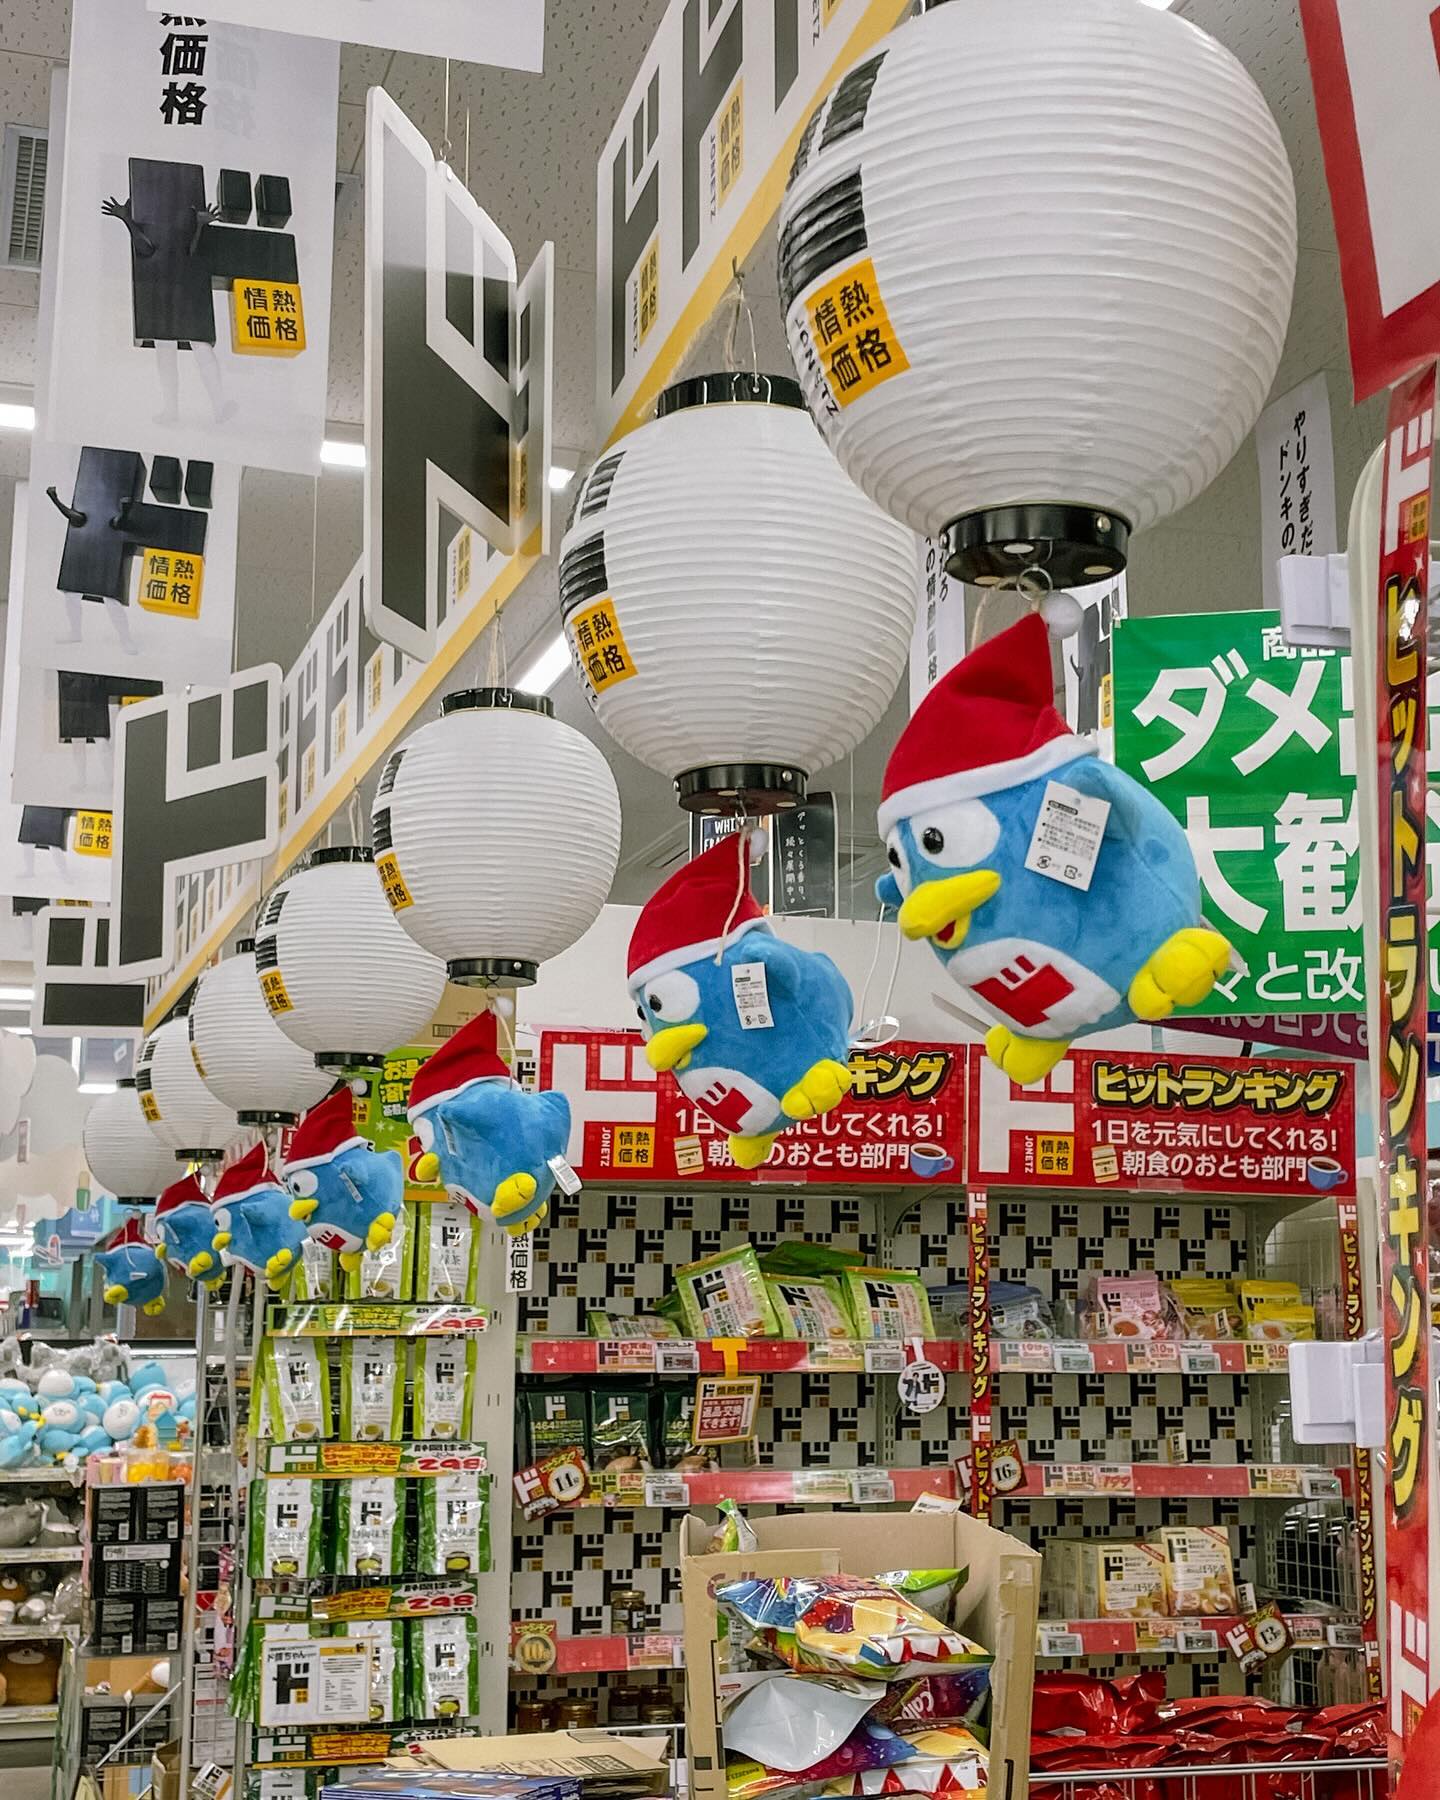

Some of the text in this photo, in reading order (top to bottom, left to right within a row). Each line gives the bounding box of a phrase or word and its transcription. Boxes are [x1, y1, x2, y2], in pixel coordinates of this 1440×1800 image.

[159, 14, 208, 125] 価格
[243, 287, 298, 313] 情熱
[815, 279, 875, 346] 情熱
[245, 315, 299, 341] 価格
[830, 329, 892, 392] 価格
[1279, 440, 1297, 555] ドンキの
[1294, 410, 1313, 555] やりすぎだ
[149, 554, 195, 580] 情熱
[145, 579, 192, 605] 価格
[577, 611, 615, 652] 情熱
[588, 644, 626, 683] 価格
[81, 816, 113, 832] 情熱
[79, 833, 110, 850] 価格
[1096, 1064, 1338, 1112] ヒットランキング
[618, 1131, 651, 1147] 情熱
[674, 1108, 943, 1138] 1日にしてくれる!
[1091, 1119, 1338, 1152] 1日を元気にしてくれる!
[600, 1127, 611, 1167] JONETZ
[618, 1148, 650, 1164] 価格
[707, 1140, 910, 1170] 朝のおとも部門
[1024, 1135, 1033, 1174] JONETZ
[1041, 1139, 1070, 1154] 情熱
[1041, 1156, 1070, 1171] 価格
[1121, 1149, 1307, 1182] 朝食のおとも部門
[969, 1222, 989, 1399] ヒットランキング
